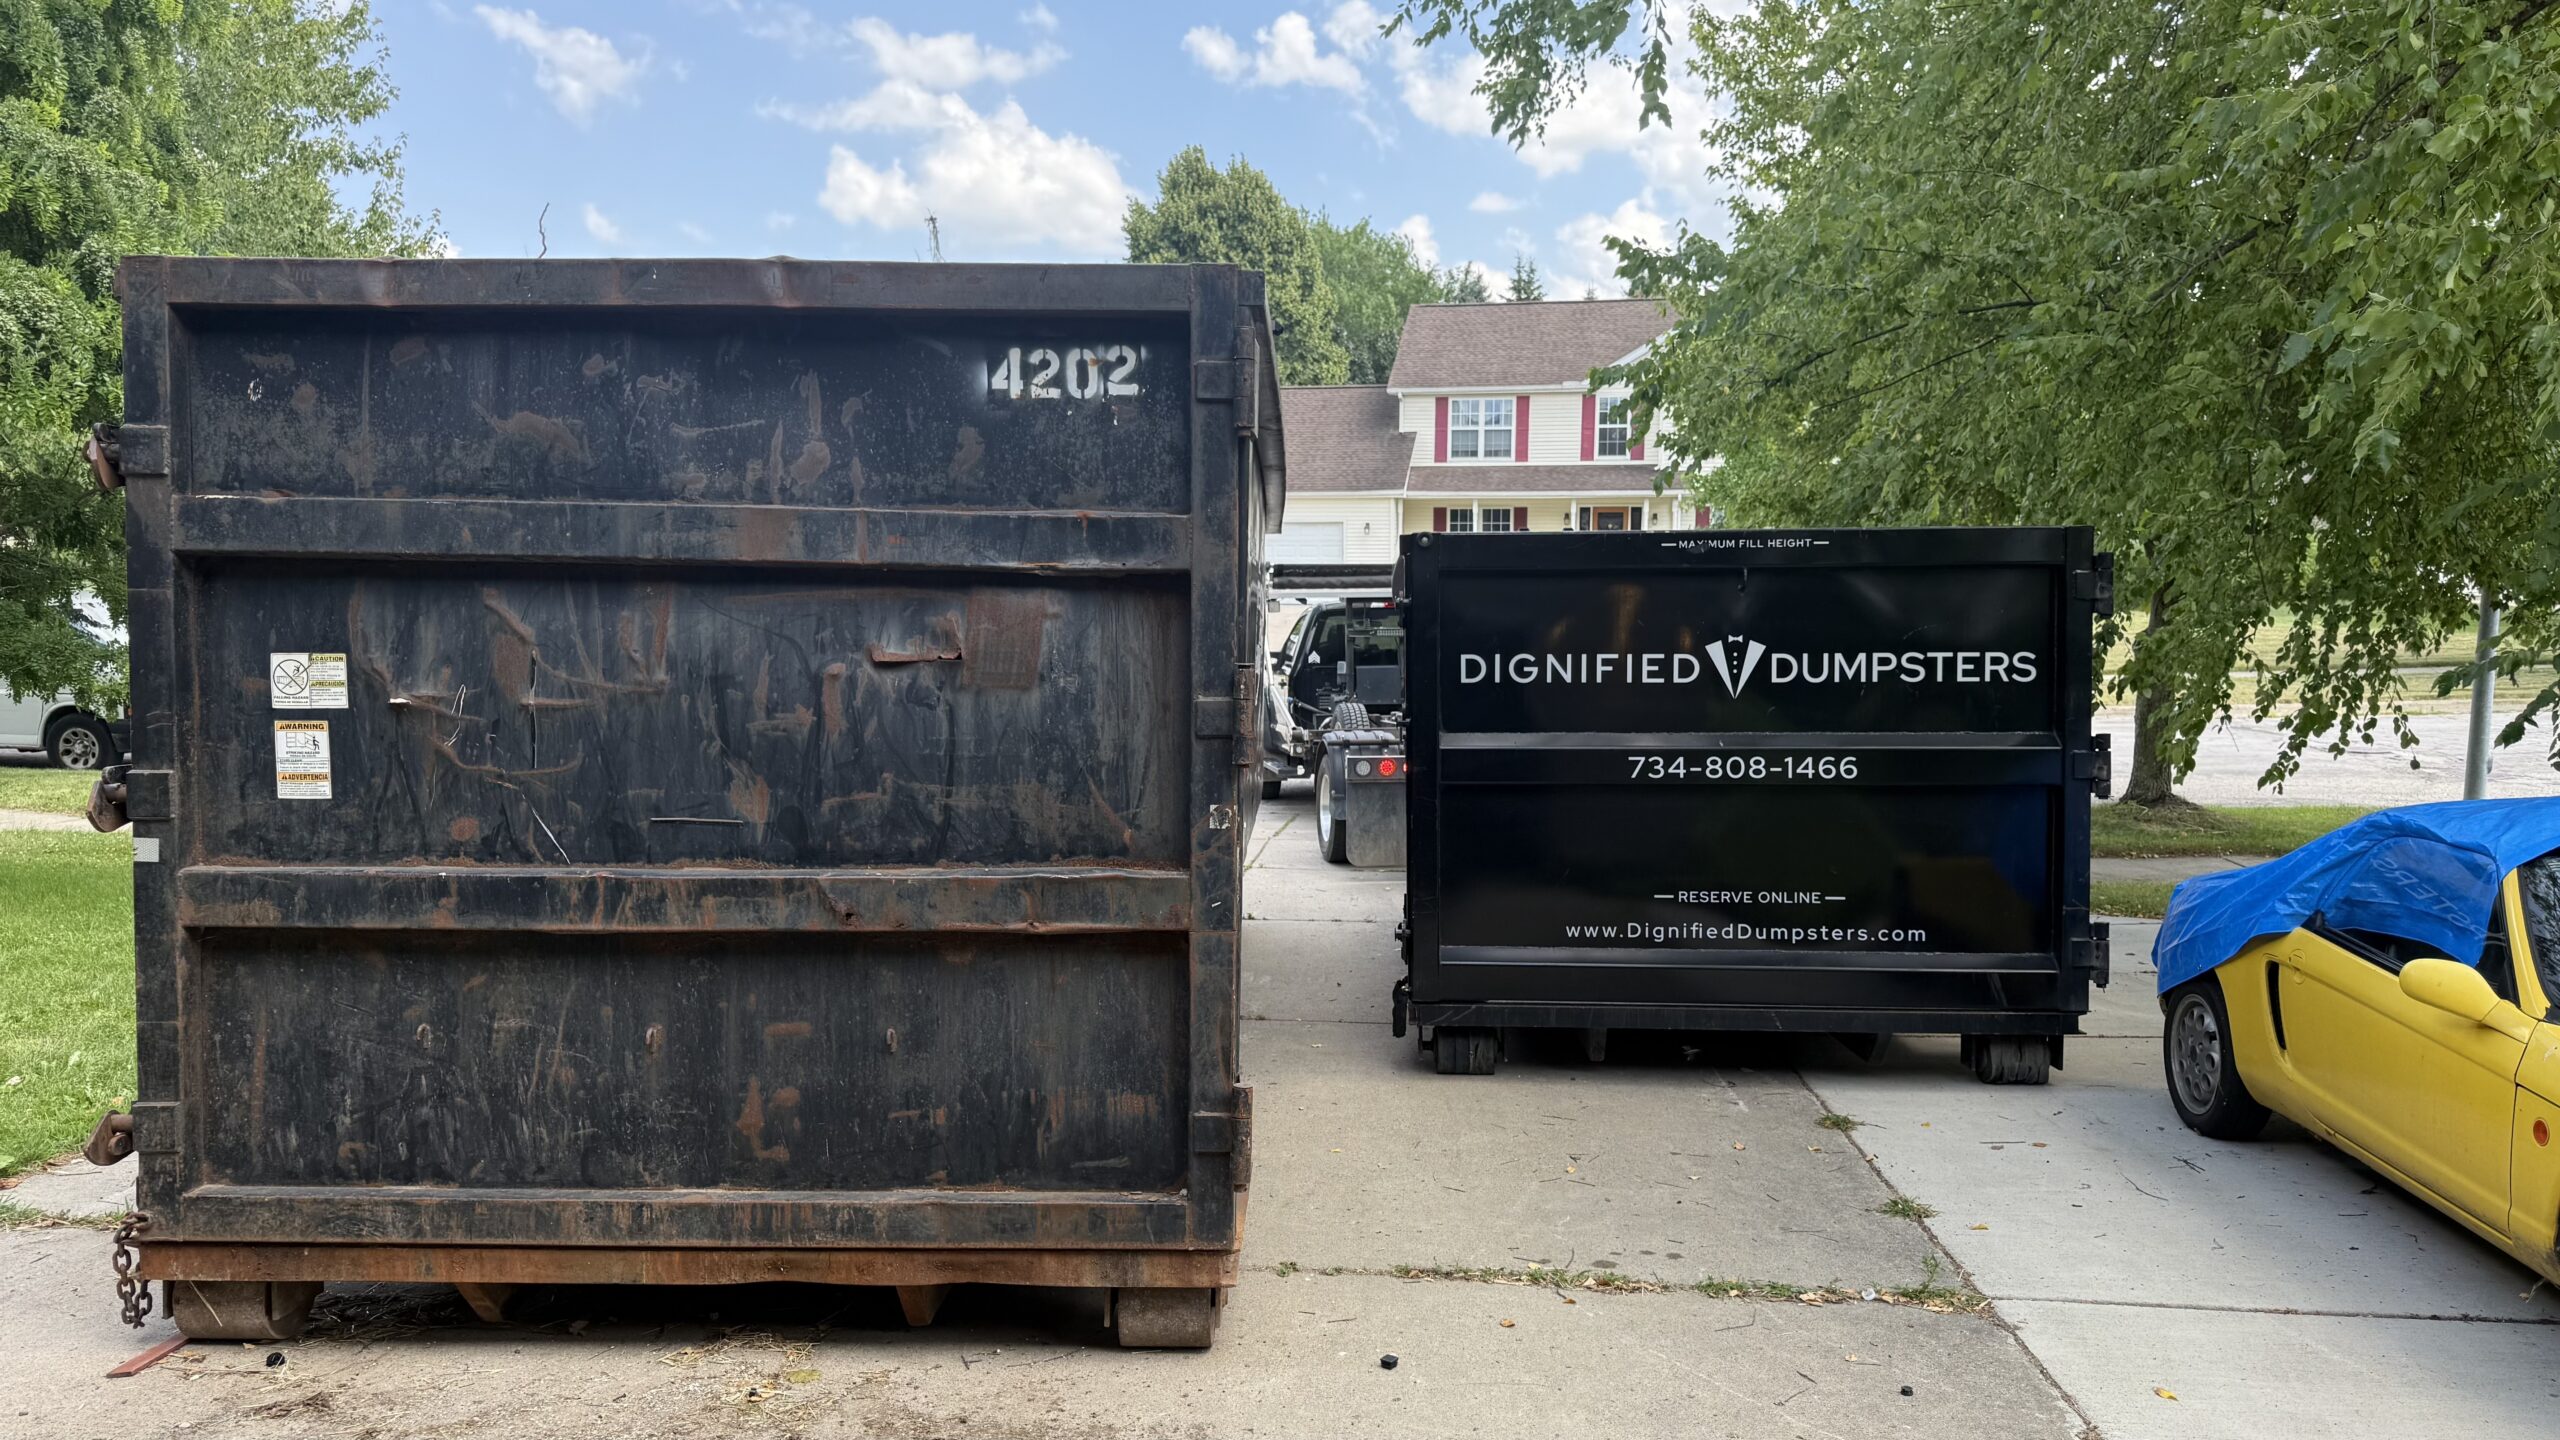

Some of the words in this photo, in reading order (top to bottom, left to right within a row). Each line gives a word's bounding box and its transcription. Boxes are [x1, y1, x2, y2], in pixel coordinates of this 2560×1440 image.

[991, 345, 1139, 399] 4202
[1739, 539, 1764, 548] FILL
[1767, 538, 1812, 548] HEIGHT
[1460, 653, 1701, 684] DIGNIFIED
[1771, 651, 2038, 684] DUMPSTERS
[288, 773, 328, 781] ADVERTENCIA
[1628, 756, 1858, 779] 734-808-1466
[1678, 890, 1753, 904] RESERVE
[1758, 891, 1822, 904] ONLINE
[1565, 922, 1927, 944] www.DignifiedDumpsters.com
